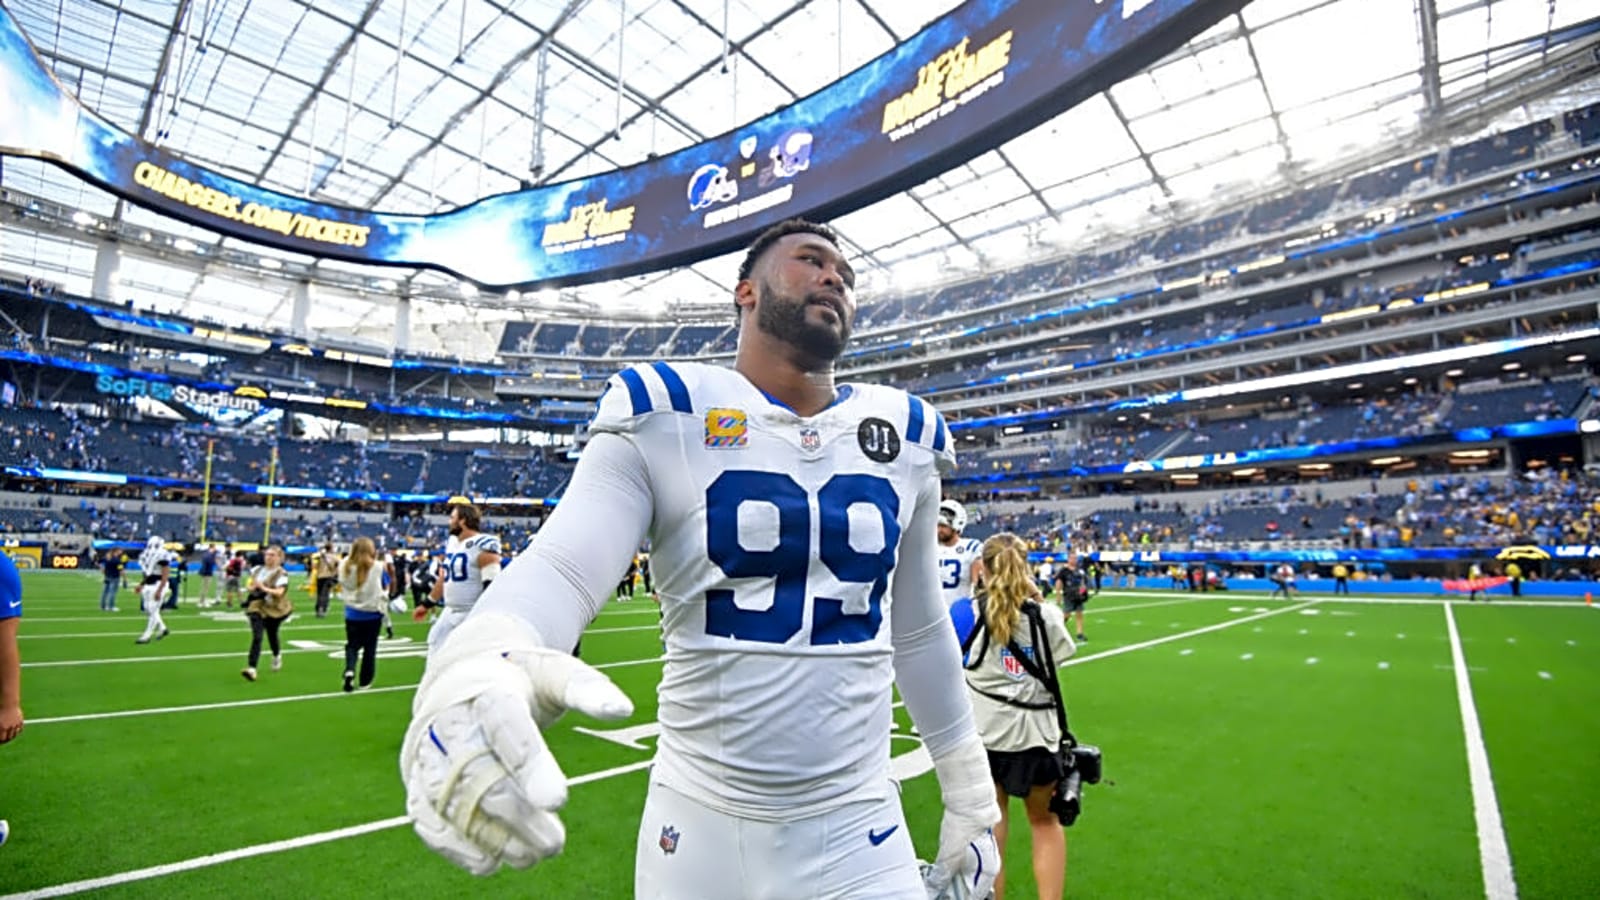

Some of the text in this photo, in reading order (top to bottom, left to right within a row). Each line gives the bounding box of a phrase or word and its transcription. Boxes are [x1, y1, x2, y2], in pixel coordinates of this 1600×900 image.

[133, 161, 370, 247] CHARGERS.COM/TICKETS
[97, 375, 146, 395] SoFi
[174, 385, 260, 412] Stadium
[705, 470, 902, 646] 99
[939, 559, 961, 589] 3
[1004, 656, 1025, 675] NF
